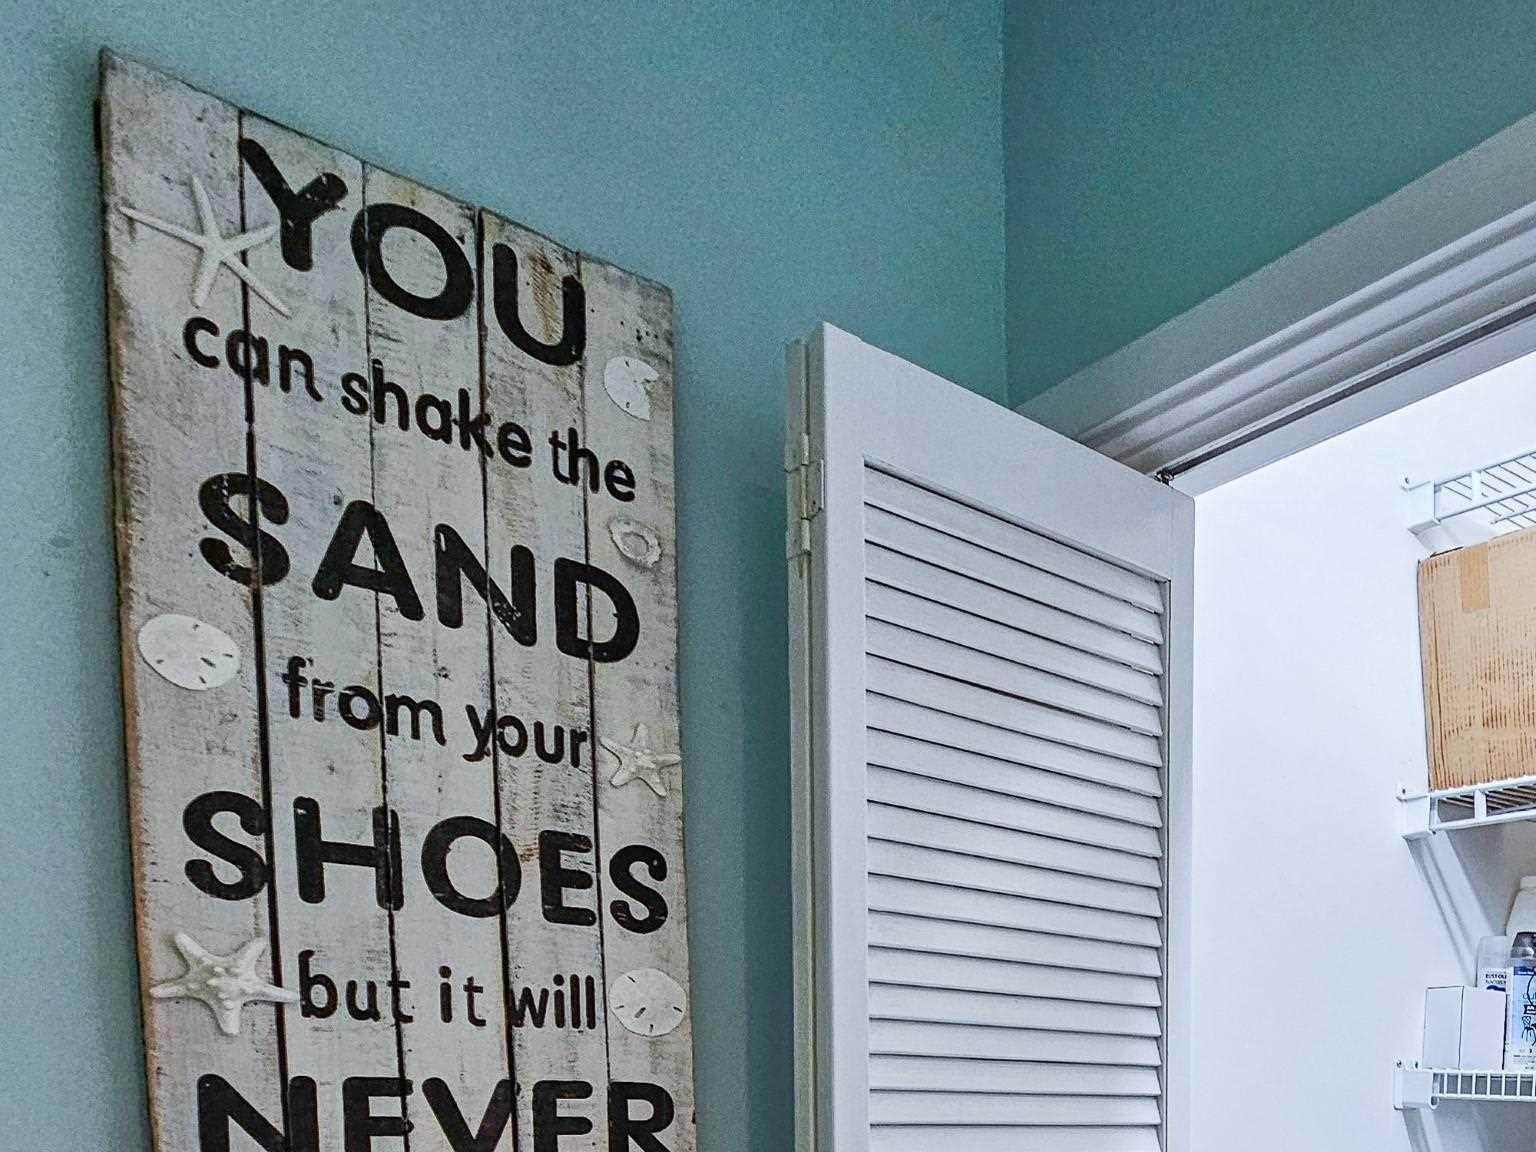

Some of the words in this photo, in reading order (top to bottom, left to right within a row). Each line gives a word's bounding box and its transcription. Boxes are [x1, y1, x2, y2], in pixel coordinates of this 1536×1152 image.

[237, 137, 587, 367] YOU
[182, 316, 325, 402] can
[341, 358, 534, 468] shake
[548, 427, 637, 502] the
[198, 472, 641, 664] SAND
[281, 655, 445, 746] from
[463, 703, 590, 768] your
[182, 789, 670, 936] SHOES
[297, 948, 414, 1025] but
[438, 965, 488, 1027] it
[509, 972, 597, 1031] will
